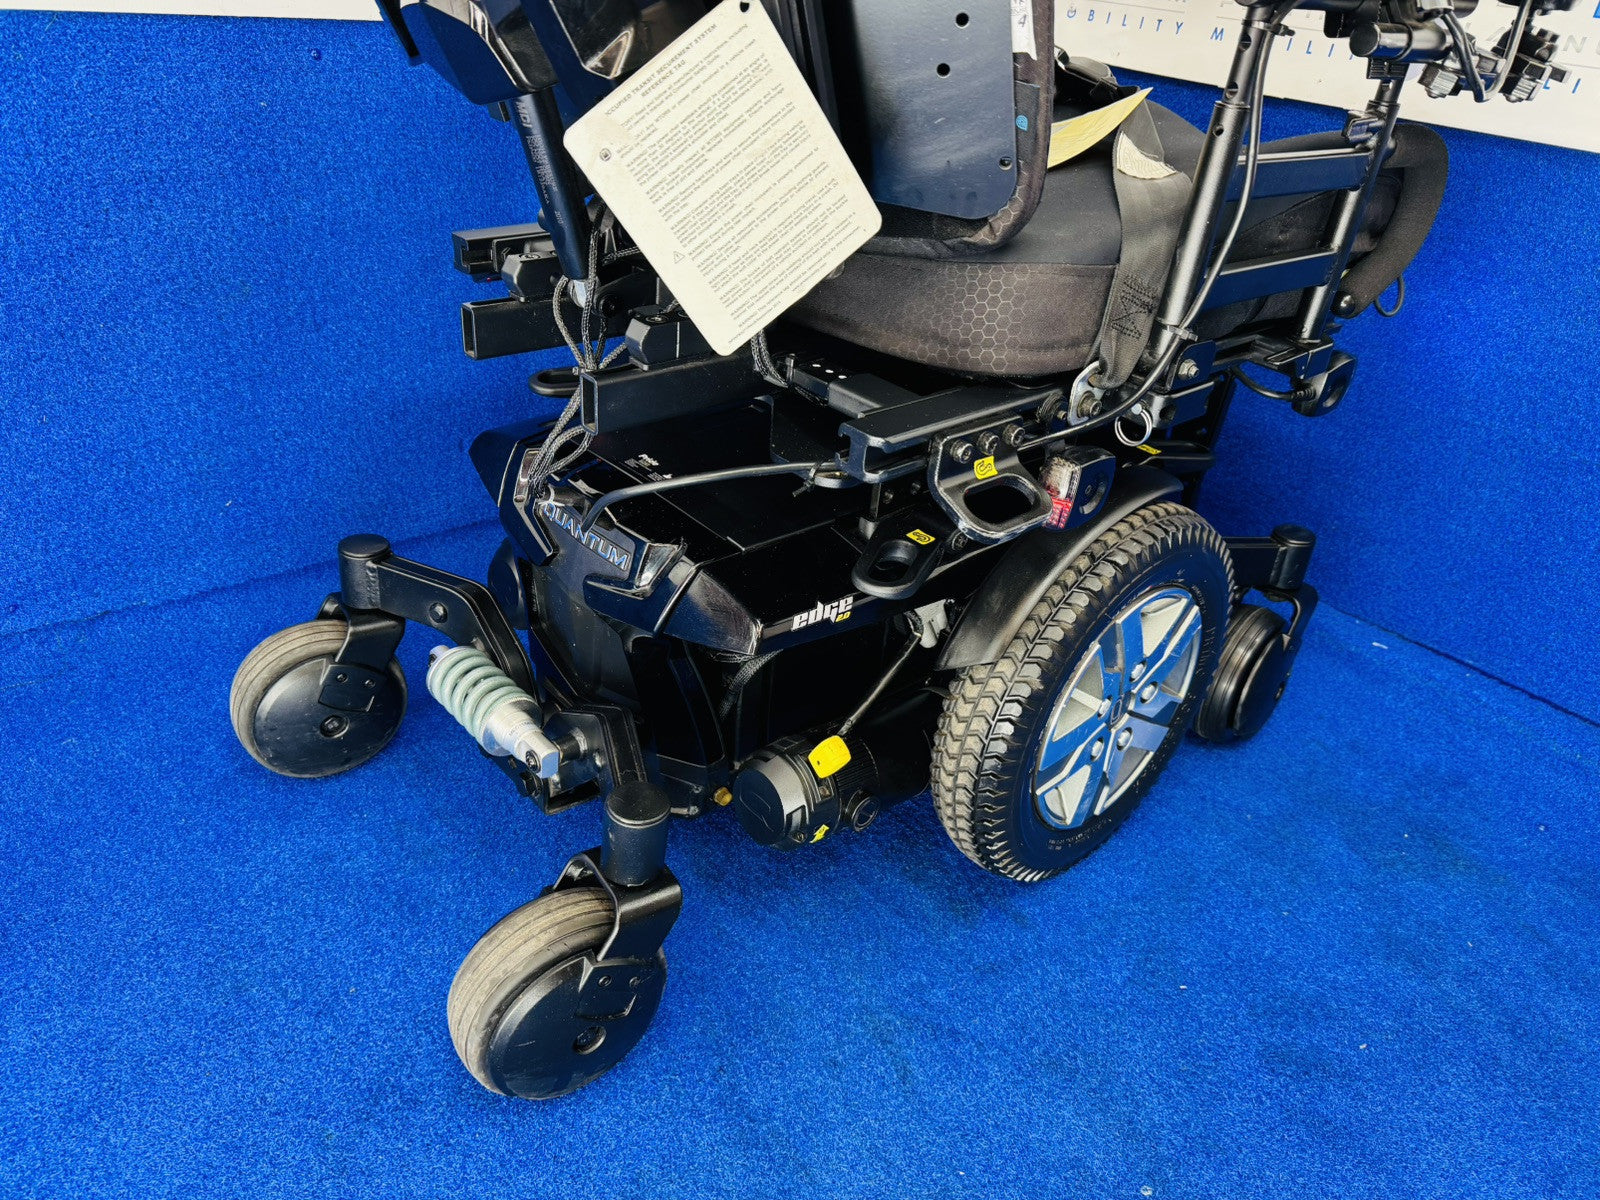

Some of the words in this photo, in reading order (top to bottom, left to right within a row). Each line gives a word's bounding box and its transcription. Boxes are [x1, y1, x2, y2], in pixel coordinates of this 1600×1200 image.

[1066, 7, 1184, 36] OBILITY
[631, 72, 655, 94] TRANSIT
[655, 41, 693, 74] SECUREMENT
[693, 22, 716, 43] SYSTEM
[640, 69, 673, 97] REFERENCE
[673, 59, 686, 71] TAG
[543, 502, 628, 571] QUANTUM
[790, 596, 854, 632] edge
[835, 610, 852, 623] 2.0
